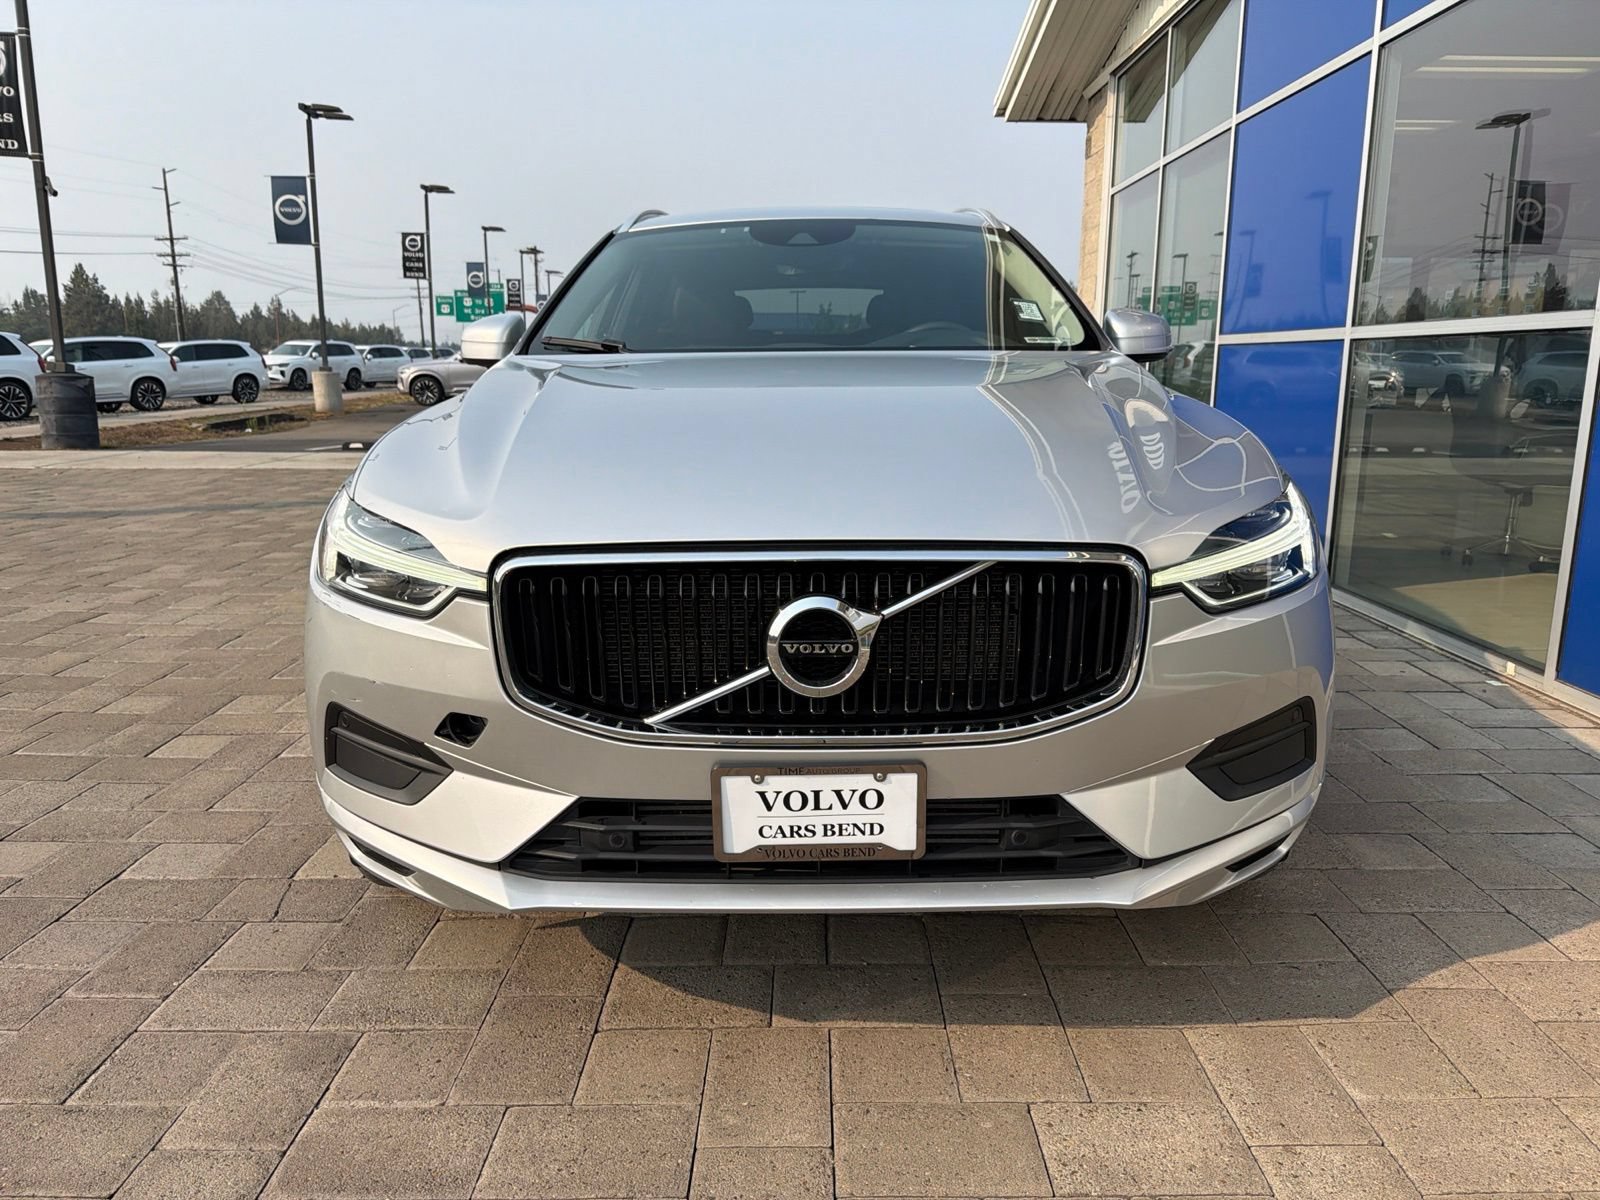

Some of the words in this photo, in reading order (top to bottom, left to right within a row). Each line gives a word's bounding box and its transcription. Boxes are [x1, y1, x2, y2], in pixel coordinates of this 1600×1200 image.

[0, 86, 15, 97] O
[0, 113, 14, 123] S
[782, 643, 854, 654] VOLVO
[777, 767, 804, 776] TIME
[755, 788, 885, 812] VOLVO
[758, 824, 817, 839] CARS
[822, 822, 885, 838] BEND
[763, 848, 807, 860] VOLVO
[809, 847, 839, 859] CARS
[842, 846, 876, 858] BEND
